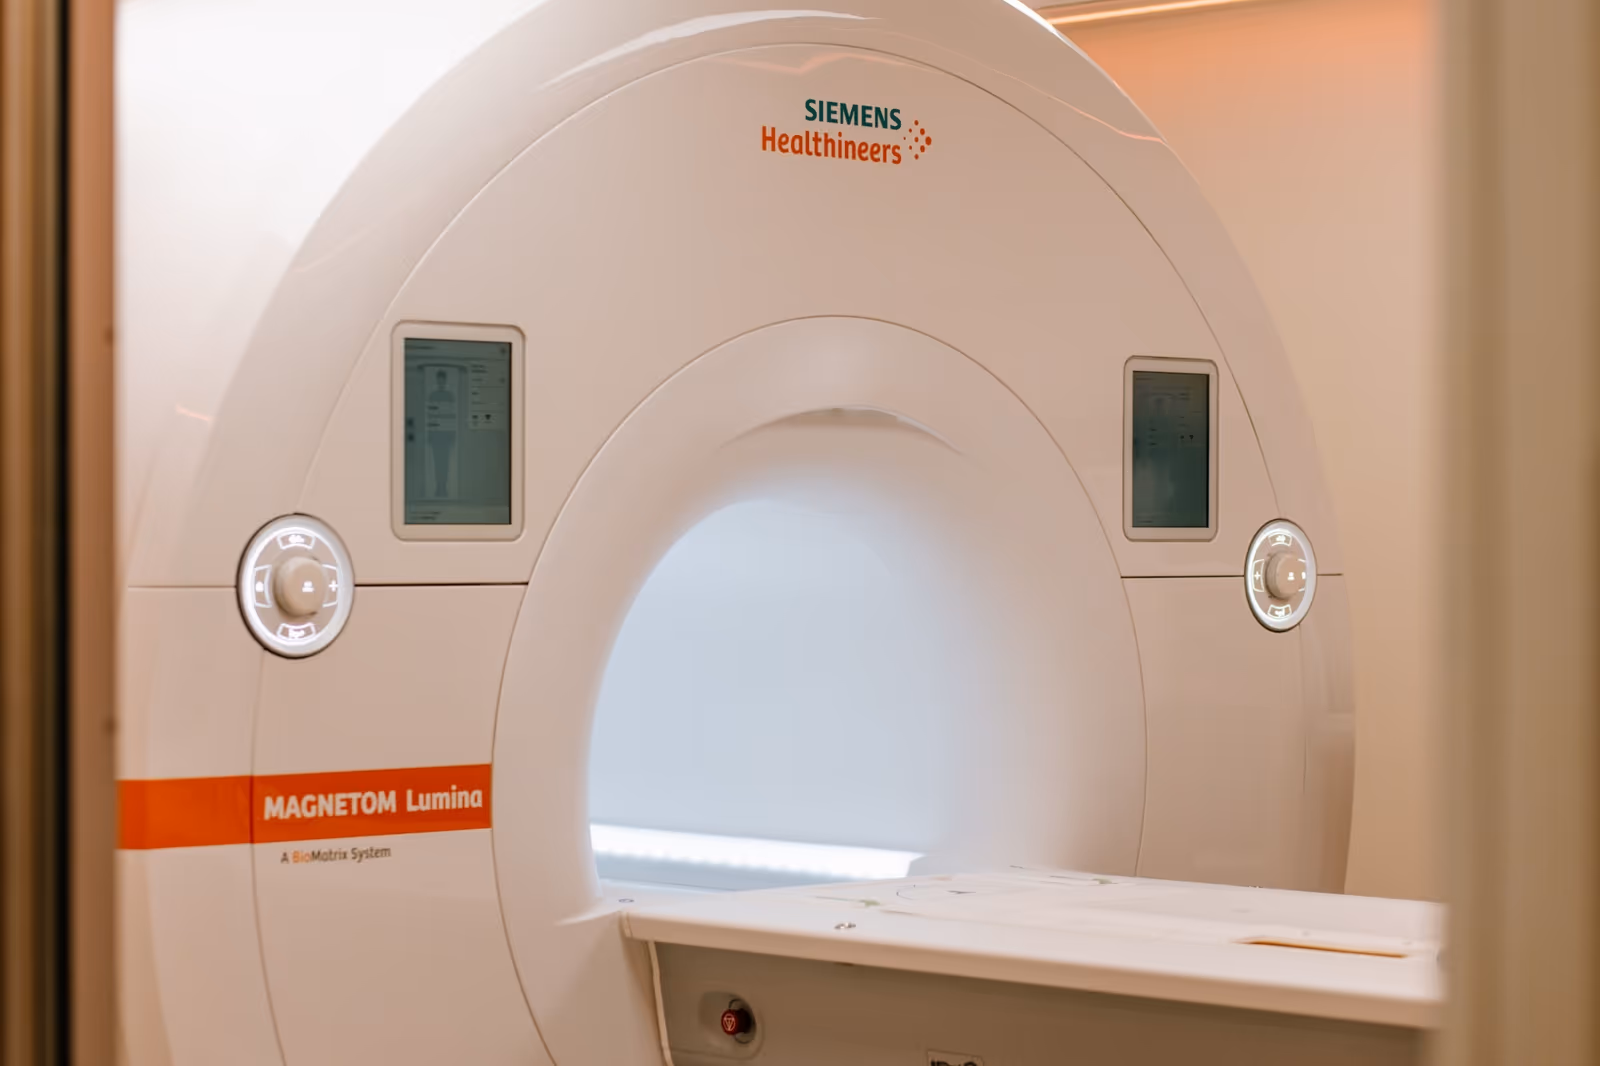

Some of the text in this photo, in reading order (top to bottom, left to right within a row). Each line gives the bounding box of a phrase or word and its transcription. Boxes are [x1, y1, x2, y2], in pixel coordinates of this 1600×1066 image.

[805, 98, 902, 130] SIEMENS
[761, 125, 902, 165] Healthineers
[264, 785, 483, 820] MAGNETOM Lumina
[281, 847, 391, 864] A BioMatrix System
